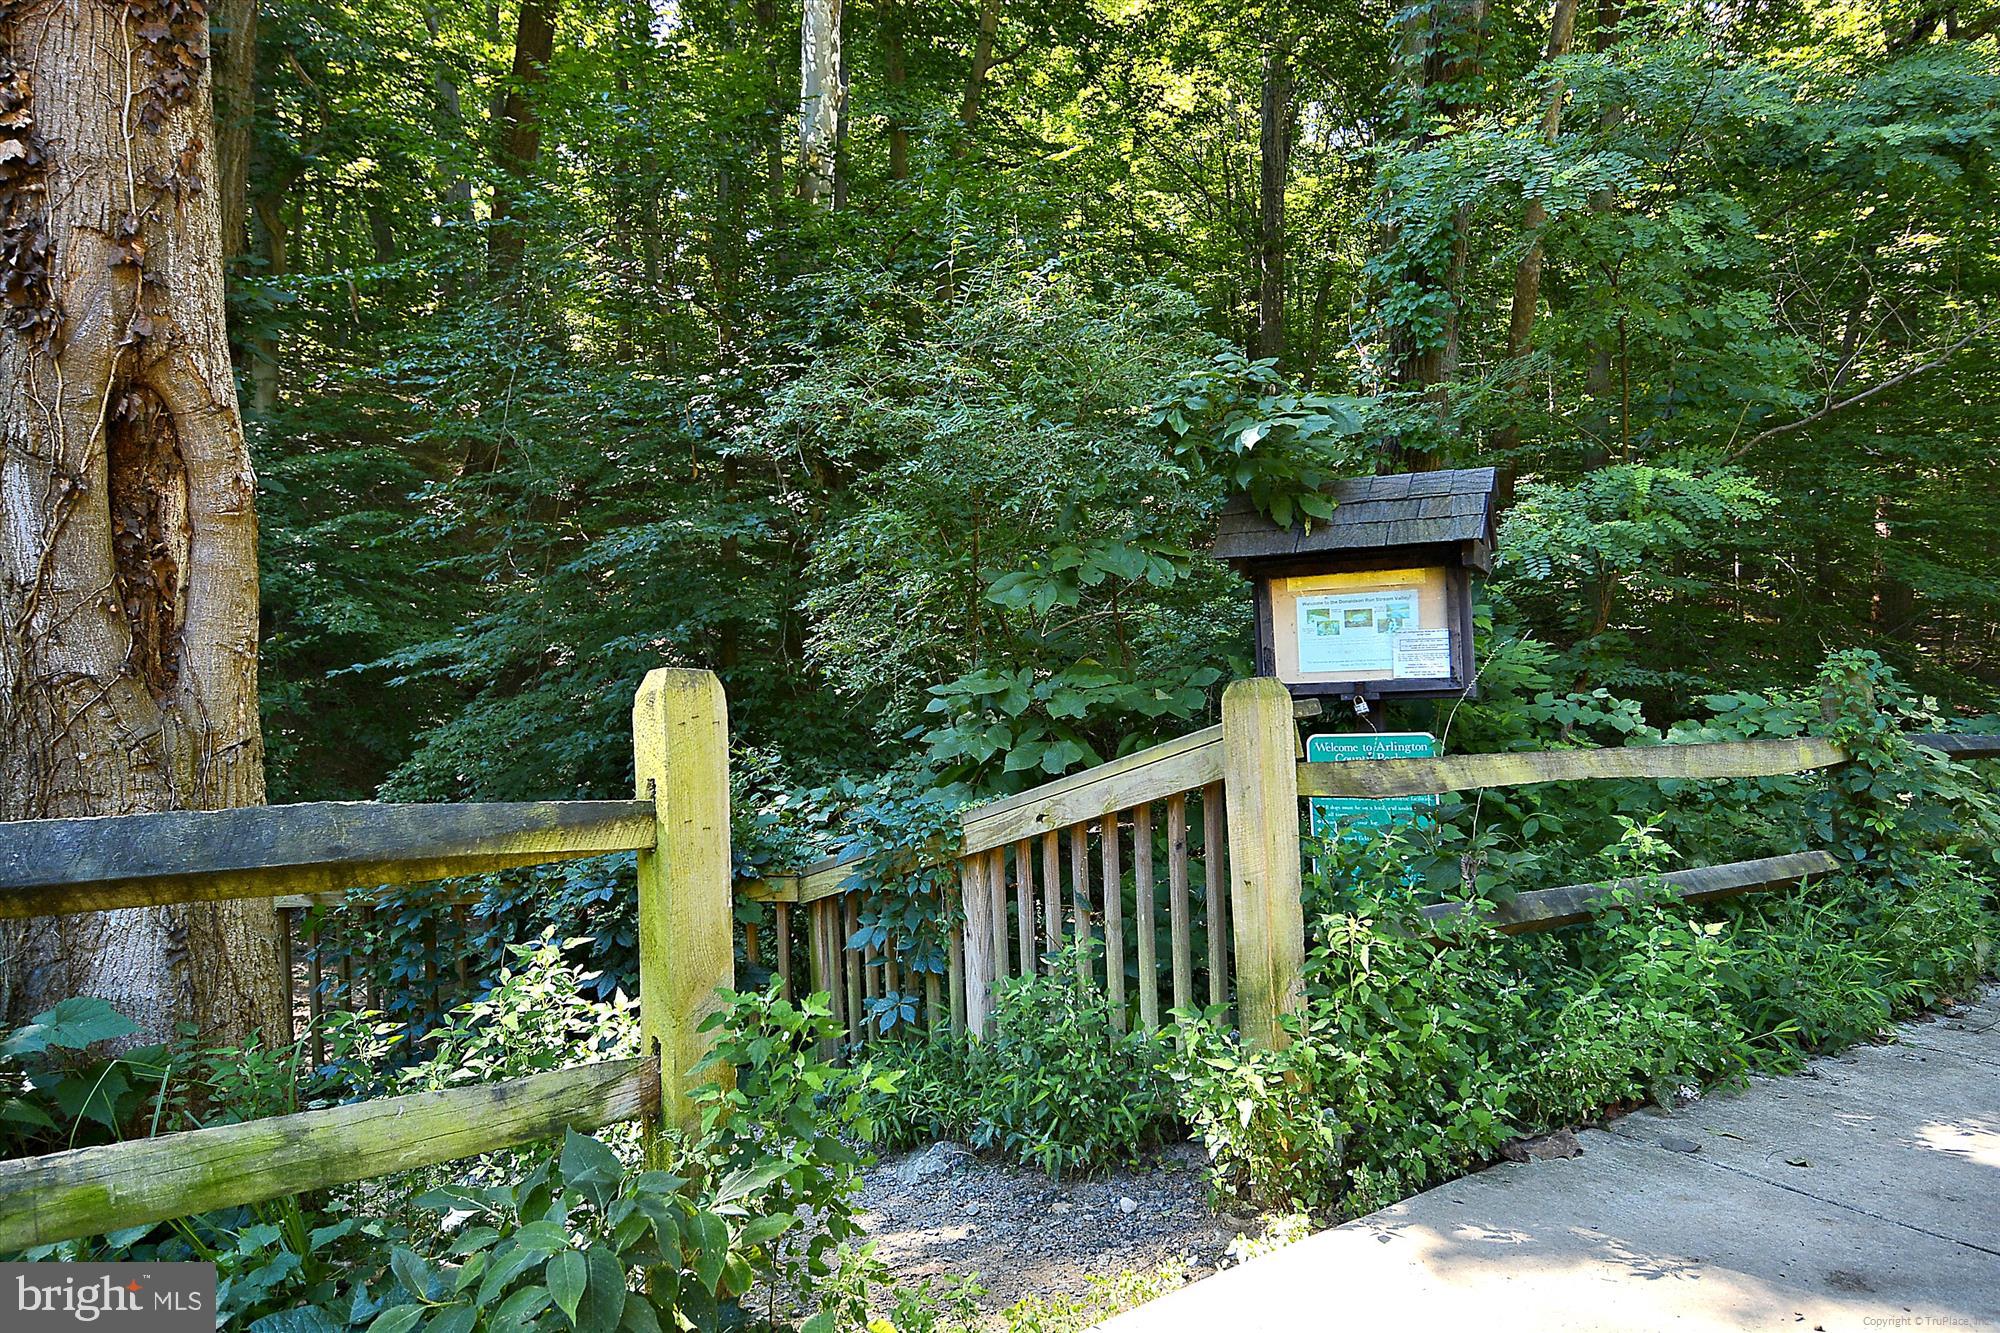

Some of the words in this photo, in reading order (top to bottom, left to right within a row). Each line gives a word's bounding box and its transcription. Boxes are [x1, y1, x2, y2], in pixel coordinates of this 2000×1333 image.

[1315, 742, 1359, 753] Welcome
[1362, 744, 1373, 752] to
[1376, 741, 1428, 754] Arlington
